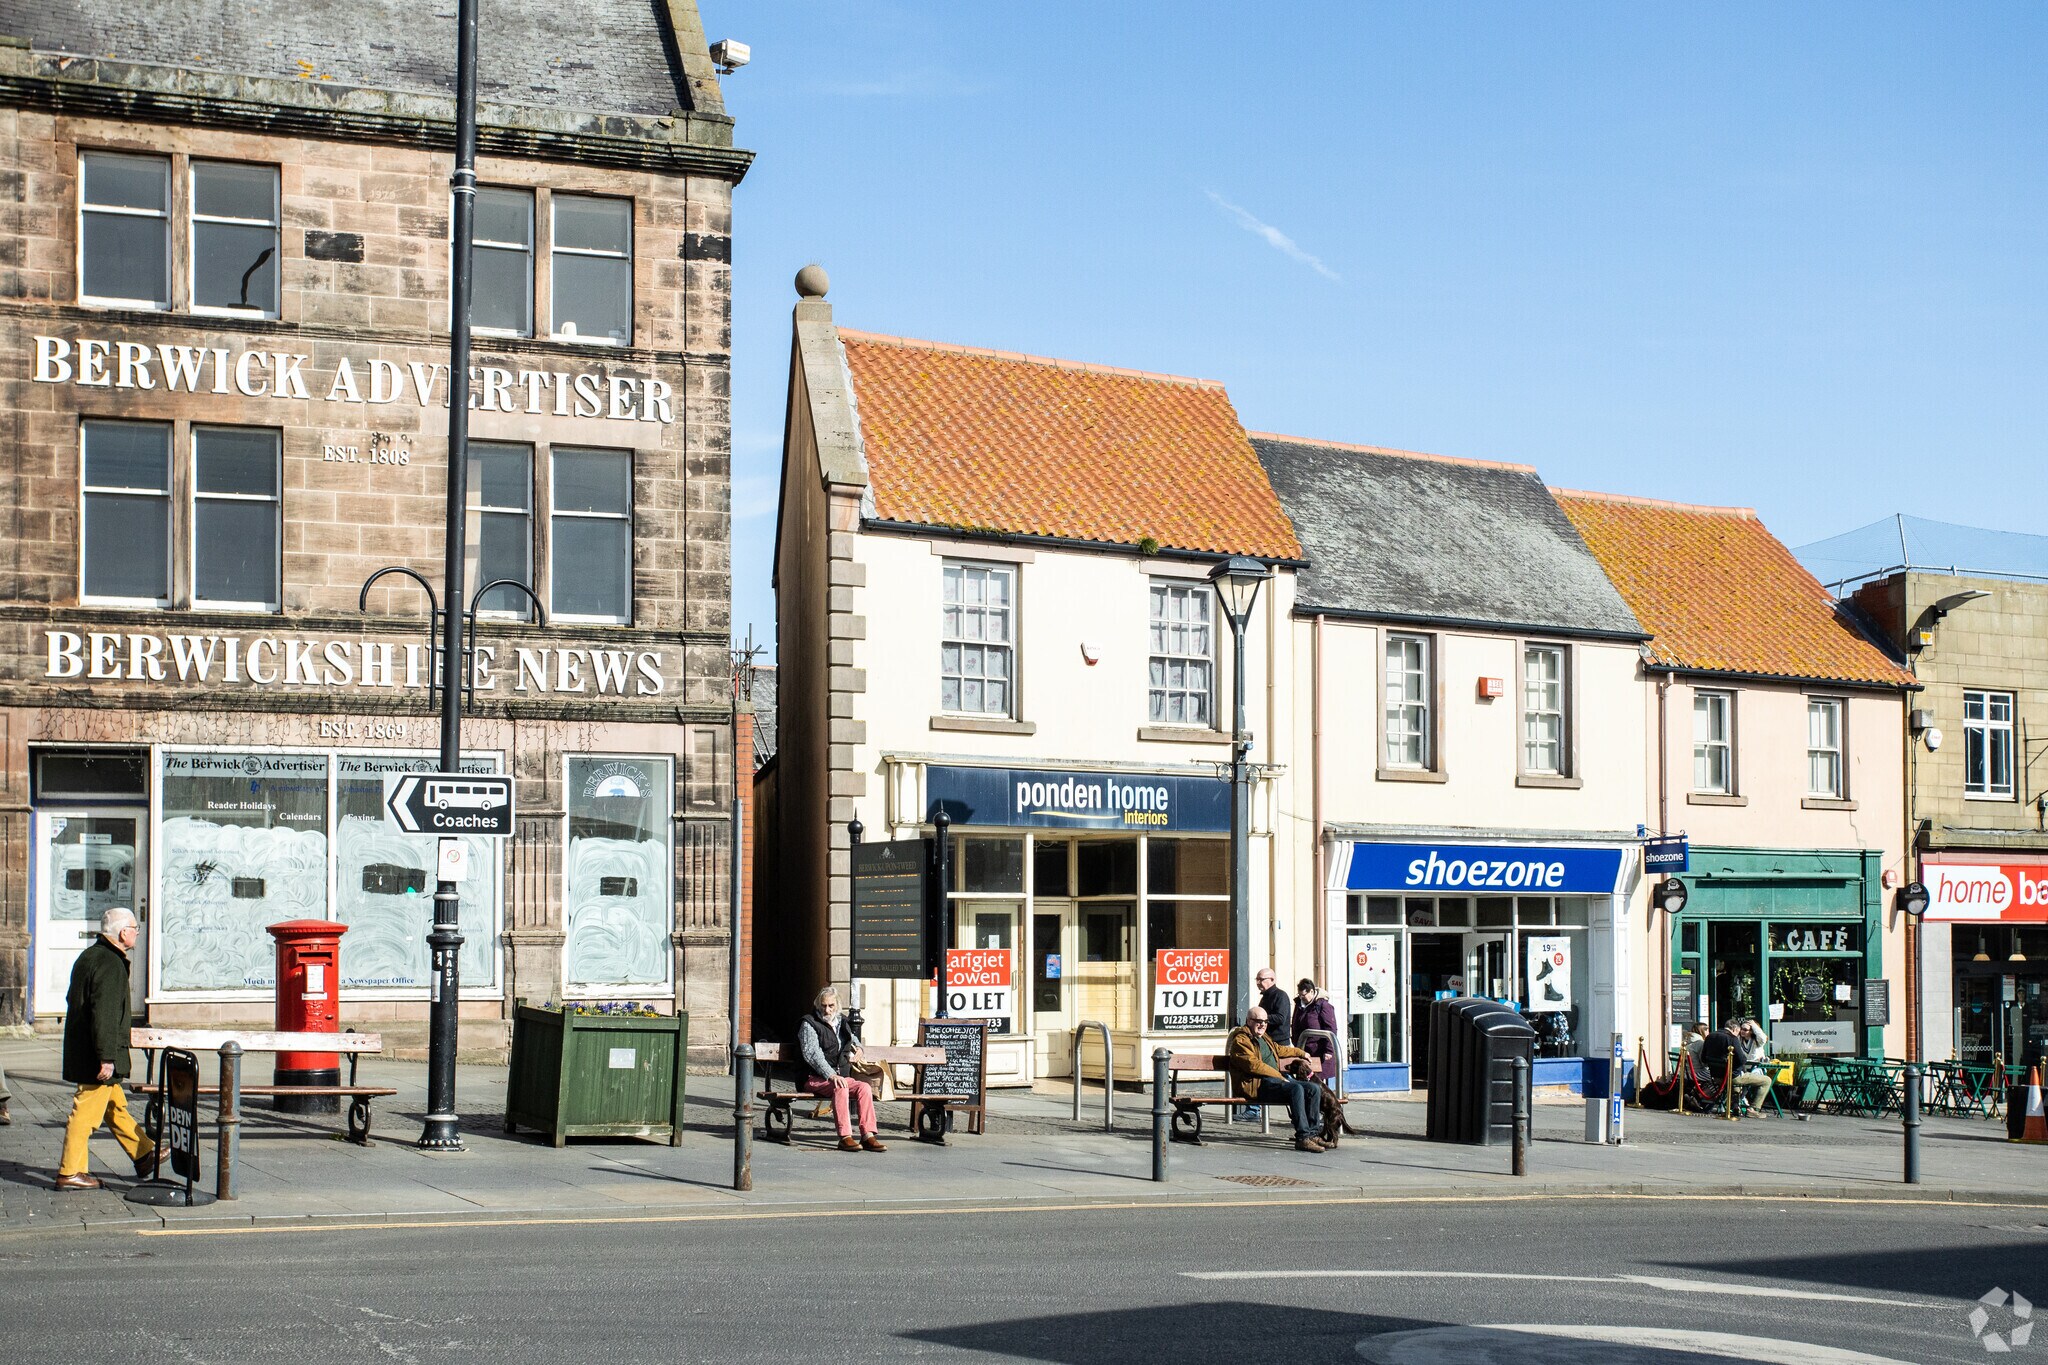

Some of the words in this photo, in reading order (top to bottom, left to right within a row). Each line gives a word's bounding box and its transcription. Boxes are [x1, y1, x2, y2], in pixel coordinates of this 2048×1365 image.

[33, 335, 310, 399] BERWICK
[323, 444, 363, 463] EST.
[369, 448, 410, 466] 1808
[514, 647, 665, 696] NEWS
[319, 721, 360, 739] EST.
[364, 723, 406, 739] 1869
[165, 757, 188, 769] The
[191, 759, 241, 770] Berwick
[262, 759, 325, 771] Advertiser
[339, 761, 361, 772] The
[364, 762, 411, 773] Berwick
[432, 764, 492, 774] Aertiser
[583, 762, 653, 799] BERWICK'S
[1017, 777, 1102, 813] ponden
[1107, 778, 1169, 811] home
[207, 801, 238, 810] Reader
[239, 801, 277, 811] Holidays
[279, 812, 322, 822] Calendars
[433, 813, 499, 828] Coaches
[1124, 809, 1169, 826] interiors
[1645, 853, 1684, 863] shoezone
[1405, 850, 1565, 887] shoezone
[1937, 872, 2006, 904] home
[1366, 943, 1371, 951] 9
[1542, 944, 1551, 952] 19
[1786, 926, 1848, 952] CAFÉ
[947, 951, 1004, 972] arigiet
[1163, 951, 1224, 972] Carigiet
[243, 977, 266, 986] Much
[348, 977, 390, 986] Newspaper
[391, 976, 415, 985] Office
[1166, 967, 1219, 983] Cowen
[947, 992, 967, 1011] O
[972, 992, 1005, 1010] LET
[1162, 990, 1188, 1008] TO
[1193, 990, 1222, 1007] LET
[1163, 1015, 1188, 1024] 01228
[1189, 1014, 1219, 1024] 544733
[171, 1106, 191, 1127] DEYN
